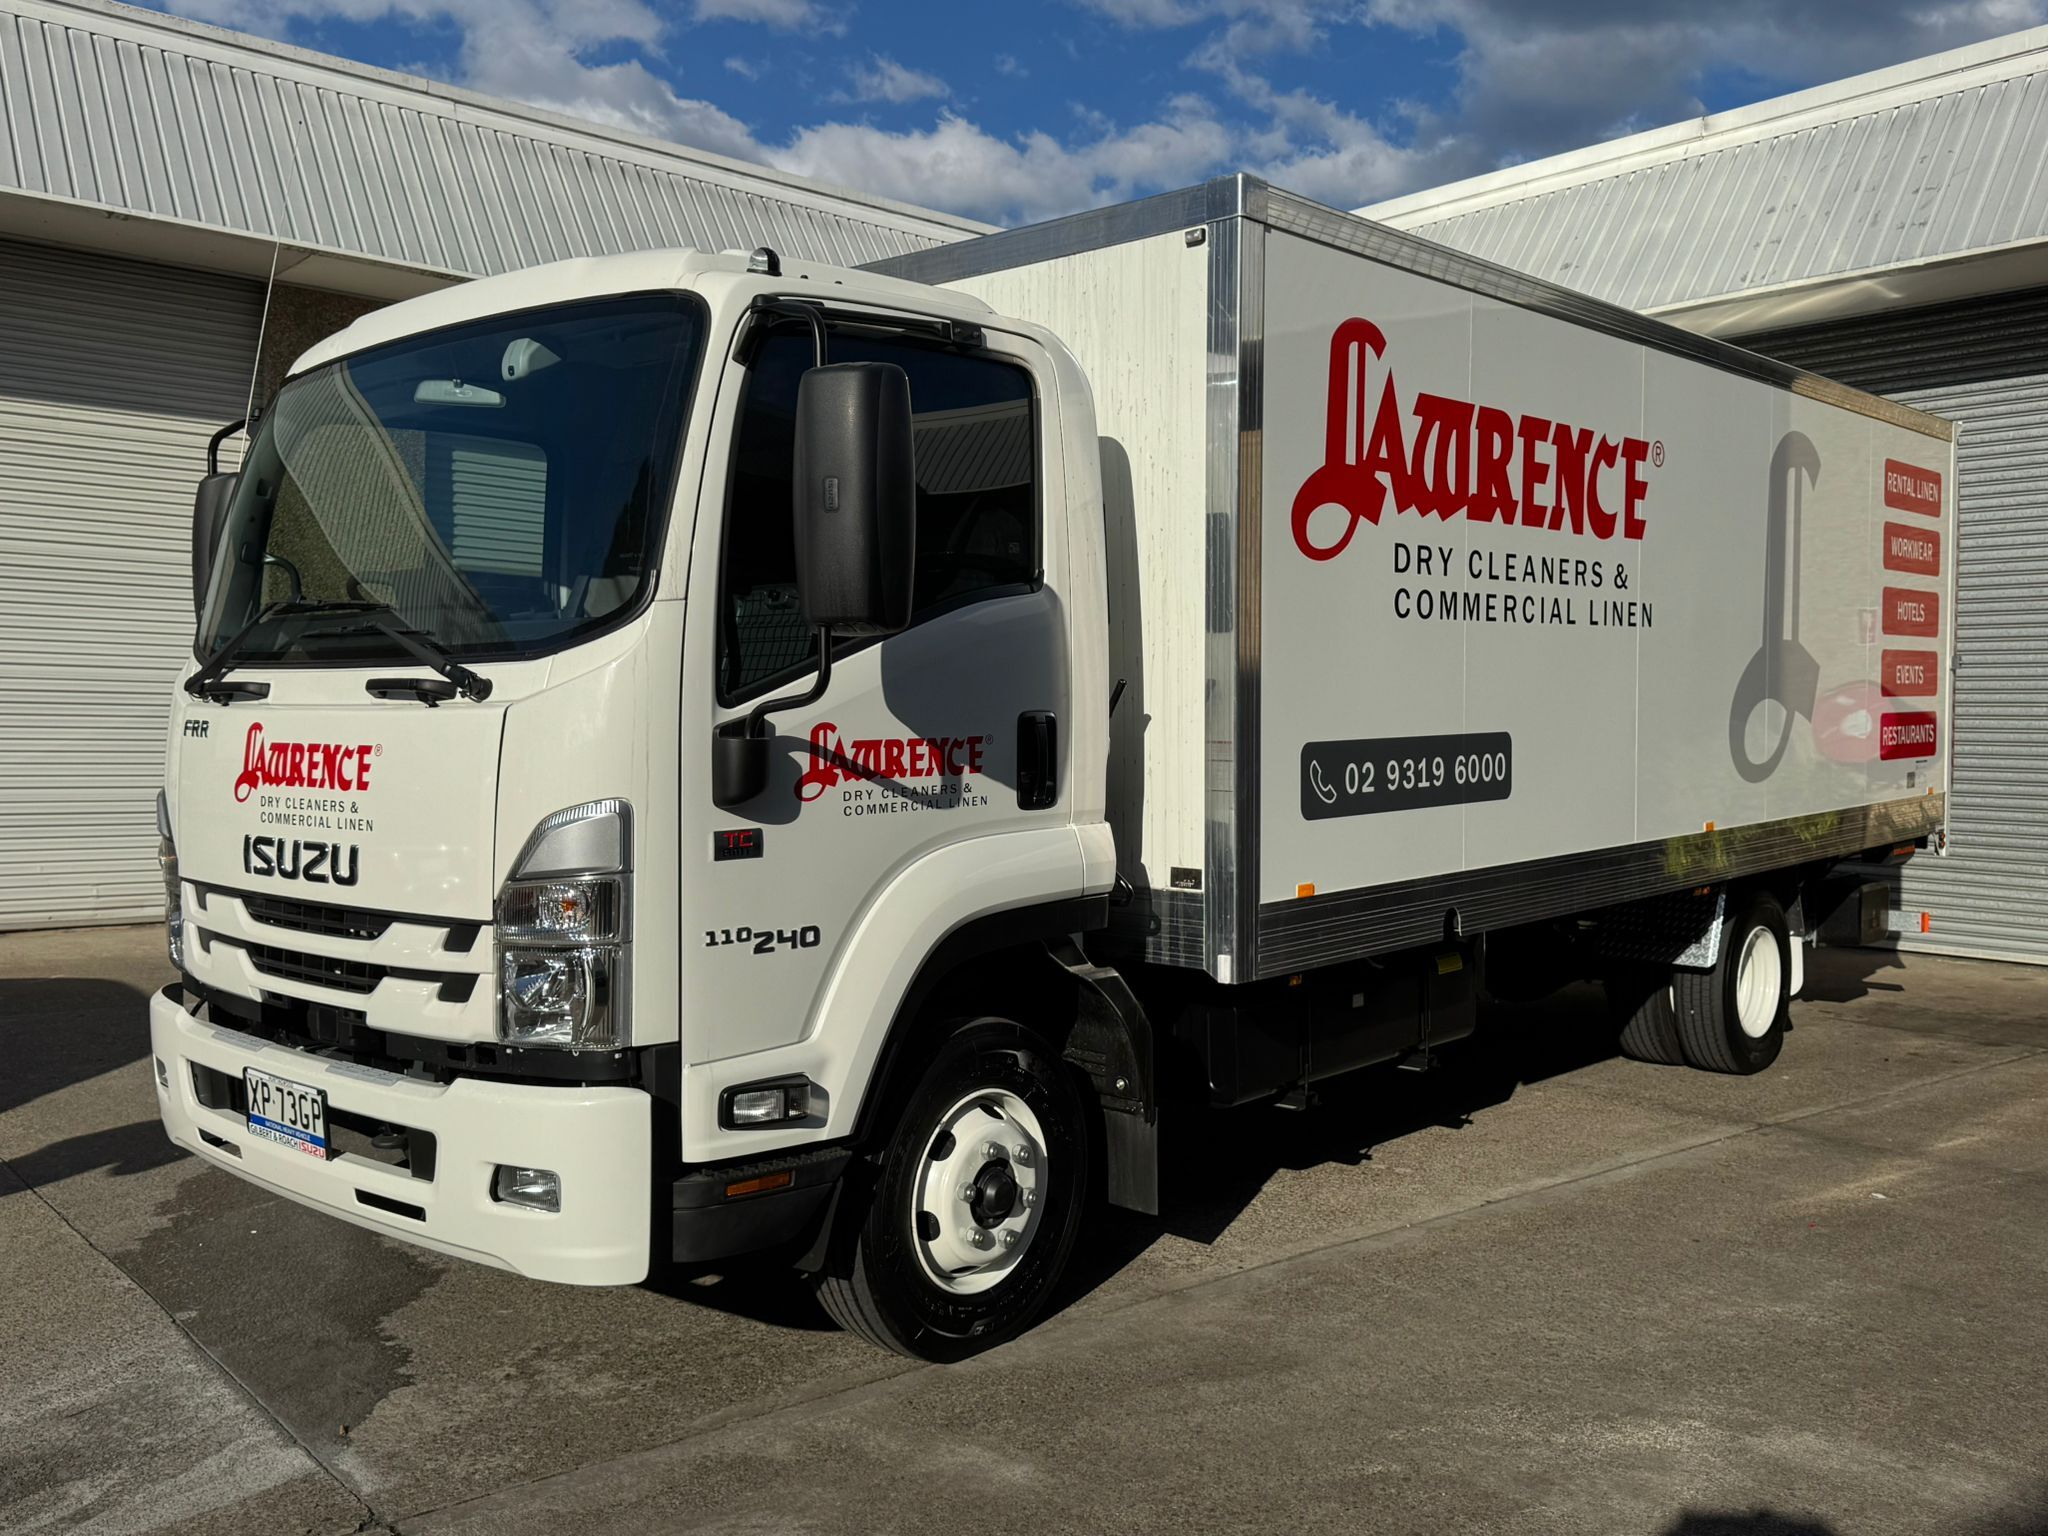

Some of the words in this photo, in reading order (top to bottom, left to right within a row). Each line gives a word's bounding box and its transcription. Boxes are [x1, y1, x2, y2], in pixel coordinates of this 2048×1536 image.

[1887, 472, 1916, 498] RENTAL
[1916, 480, 1939, 503] LINEN
[1890, 535, 1933, 562] WORKWEAR
[1393, 542, 1454, 577] DRY
[1468, 549, 1603, 588] CLEANERS
[1614, 562, 1629, 590] &
[1393, 587, 1577, 625] COMMERCIAL
[1589, 597, 1653, 628] LINEN
[1897, 601, 1925, 622] HOTELS
[1896, 665, 1924, 685] EVENTS
[184, 719, 210, 738] FRR
[1882, 724, 1935, 746] RESTAURANTS
[1345, 761, 1375, 794] 02
[1386, 756, 1445, 791] 9319
[1454, 752, 1506, 784] 6000
[843, 789, 873, 802] DRY
[881, 783, 957, 799] CLEANERS
[963, 782, 973, 794] &
[260, 795, 280, 808] DRY
[285, 798, 345, 813] CLEANERS
[350, 801, 359, 814] &
[843, 799, 943, 817] COMMERCIAL
[949, 795, 988, 809] LINEN
[260, 811, 331, 829] COMMERCIAL
[337, 817, 374, 832] LINEN
[720, 831, 753, 849] TC
[243, 834, 360, 887] ISUZU
[705, 926, 752, 947] 110
[753, 925, 821, 955] 240
